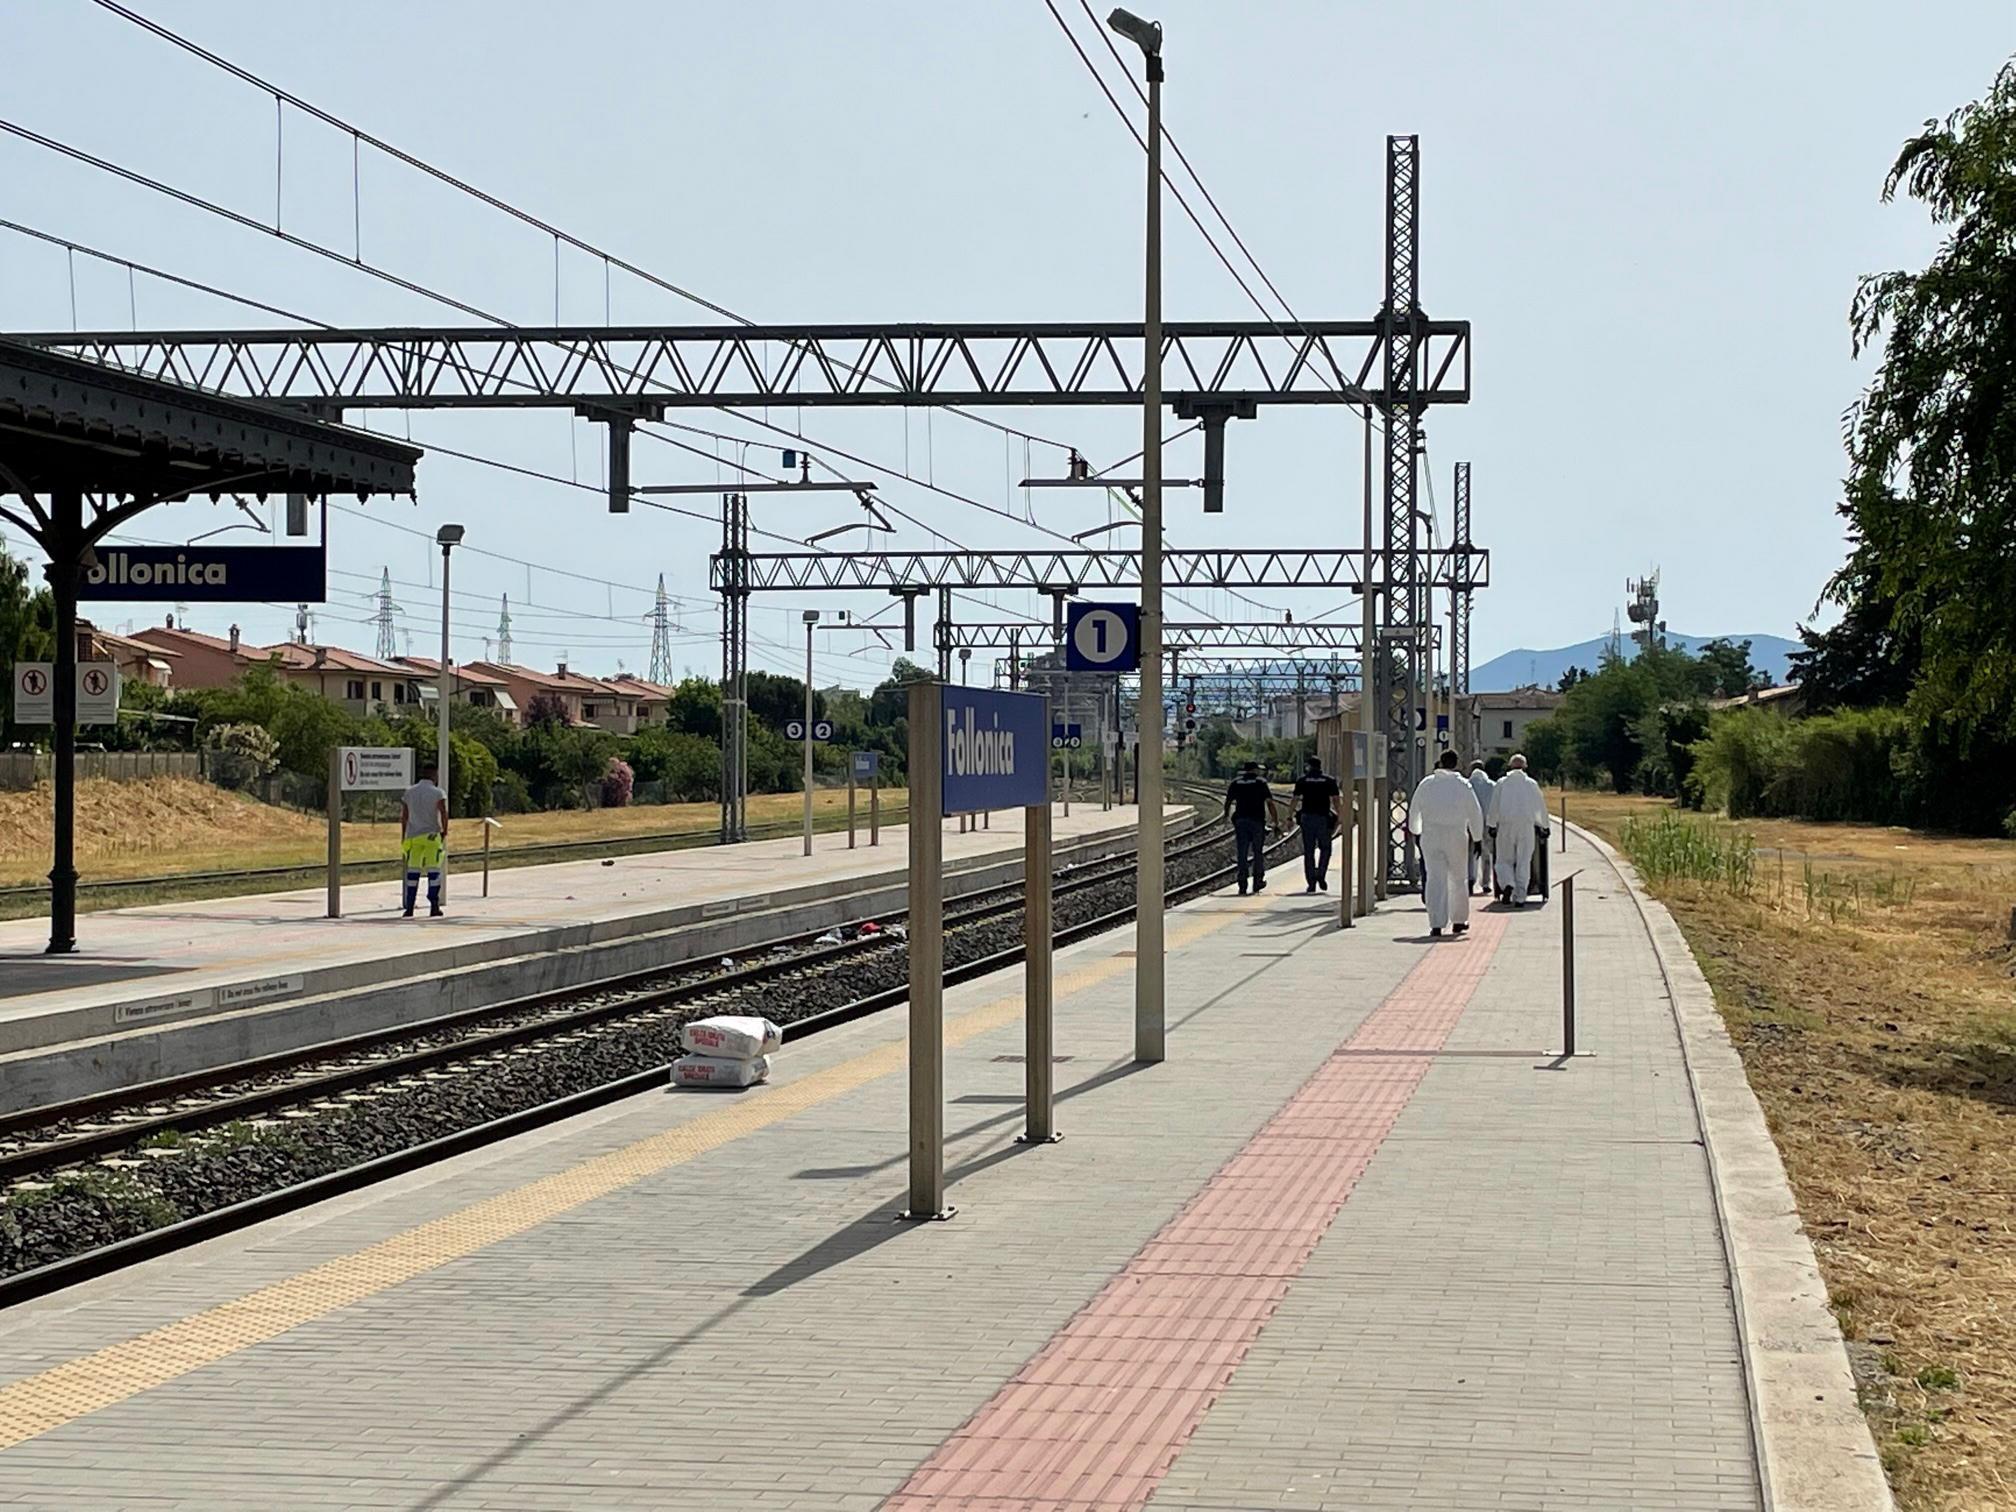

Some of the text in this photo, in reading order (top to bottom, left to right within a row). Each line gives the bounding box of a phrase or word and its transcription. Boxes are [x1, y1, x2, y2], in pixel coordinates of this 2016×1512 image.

[87, 552, 227, 585] ollonica
[1092, 619, 1107, 654] 1
[947, 706, 1015, 777] Follonica
